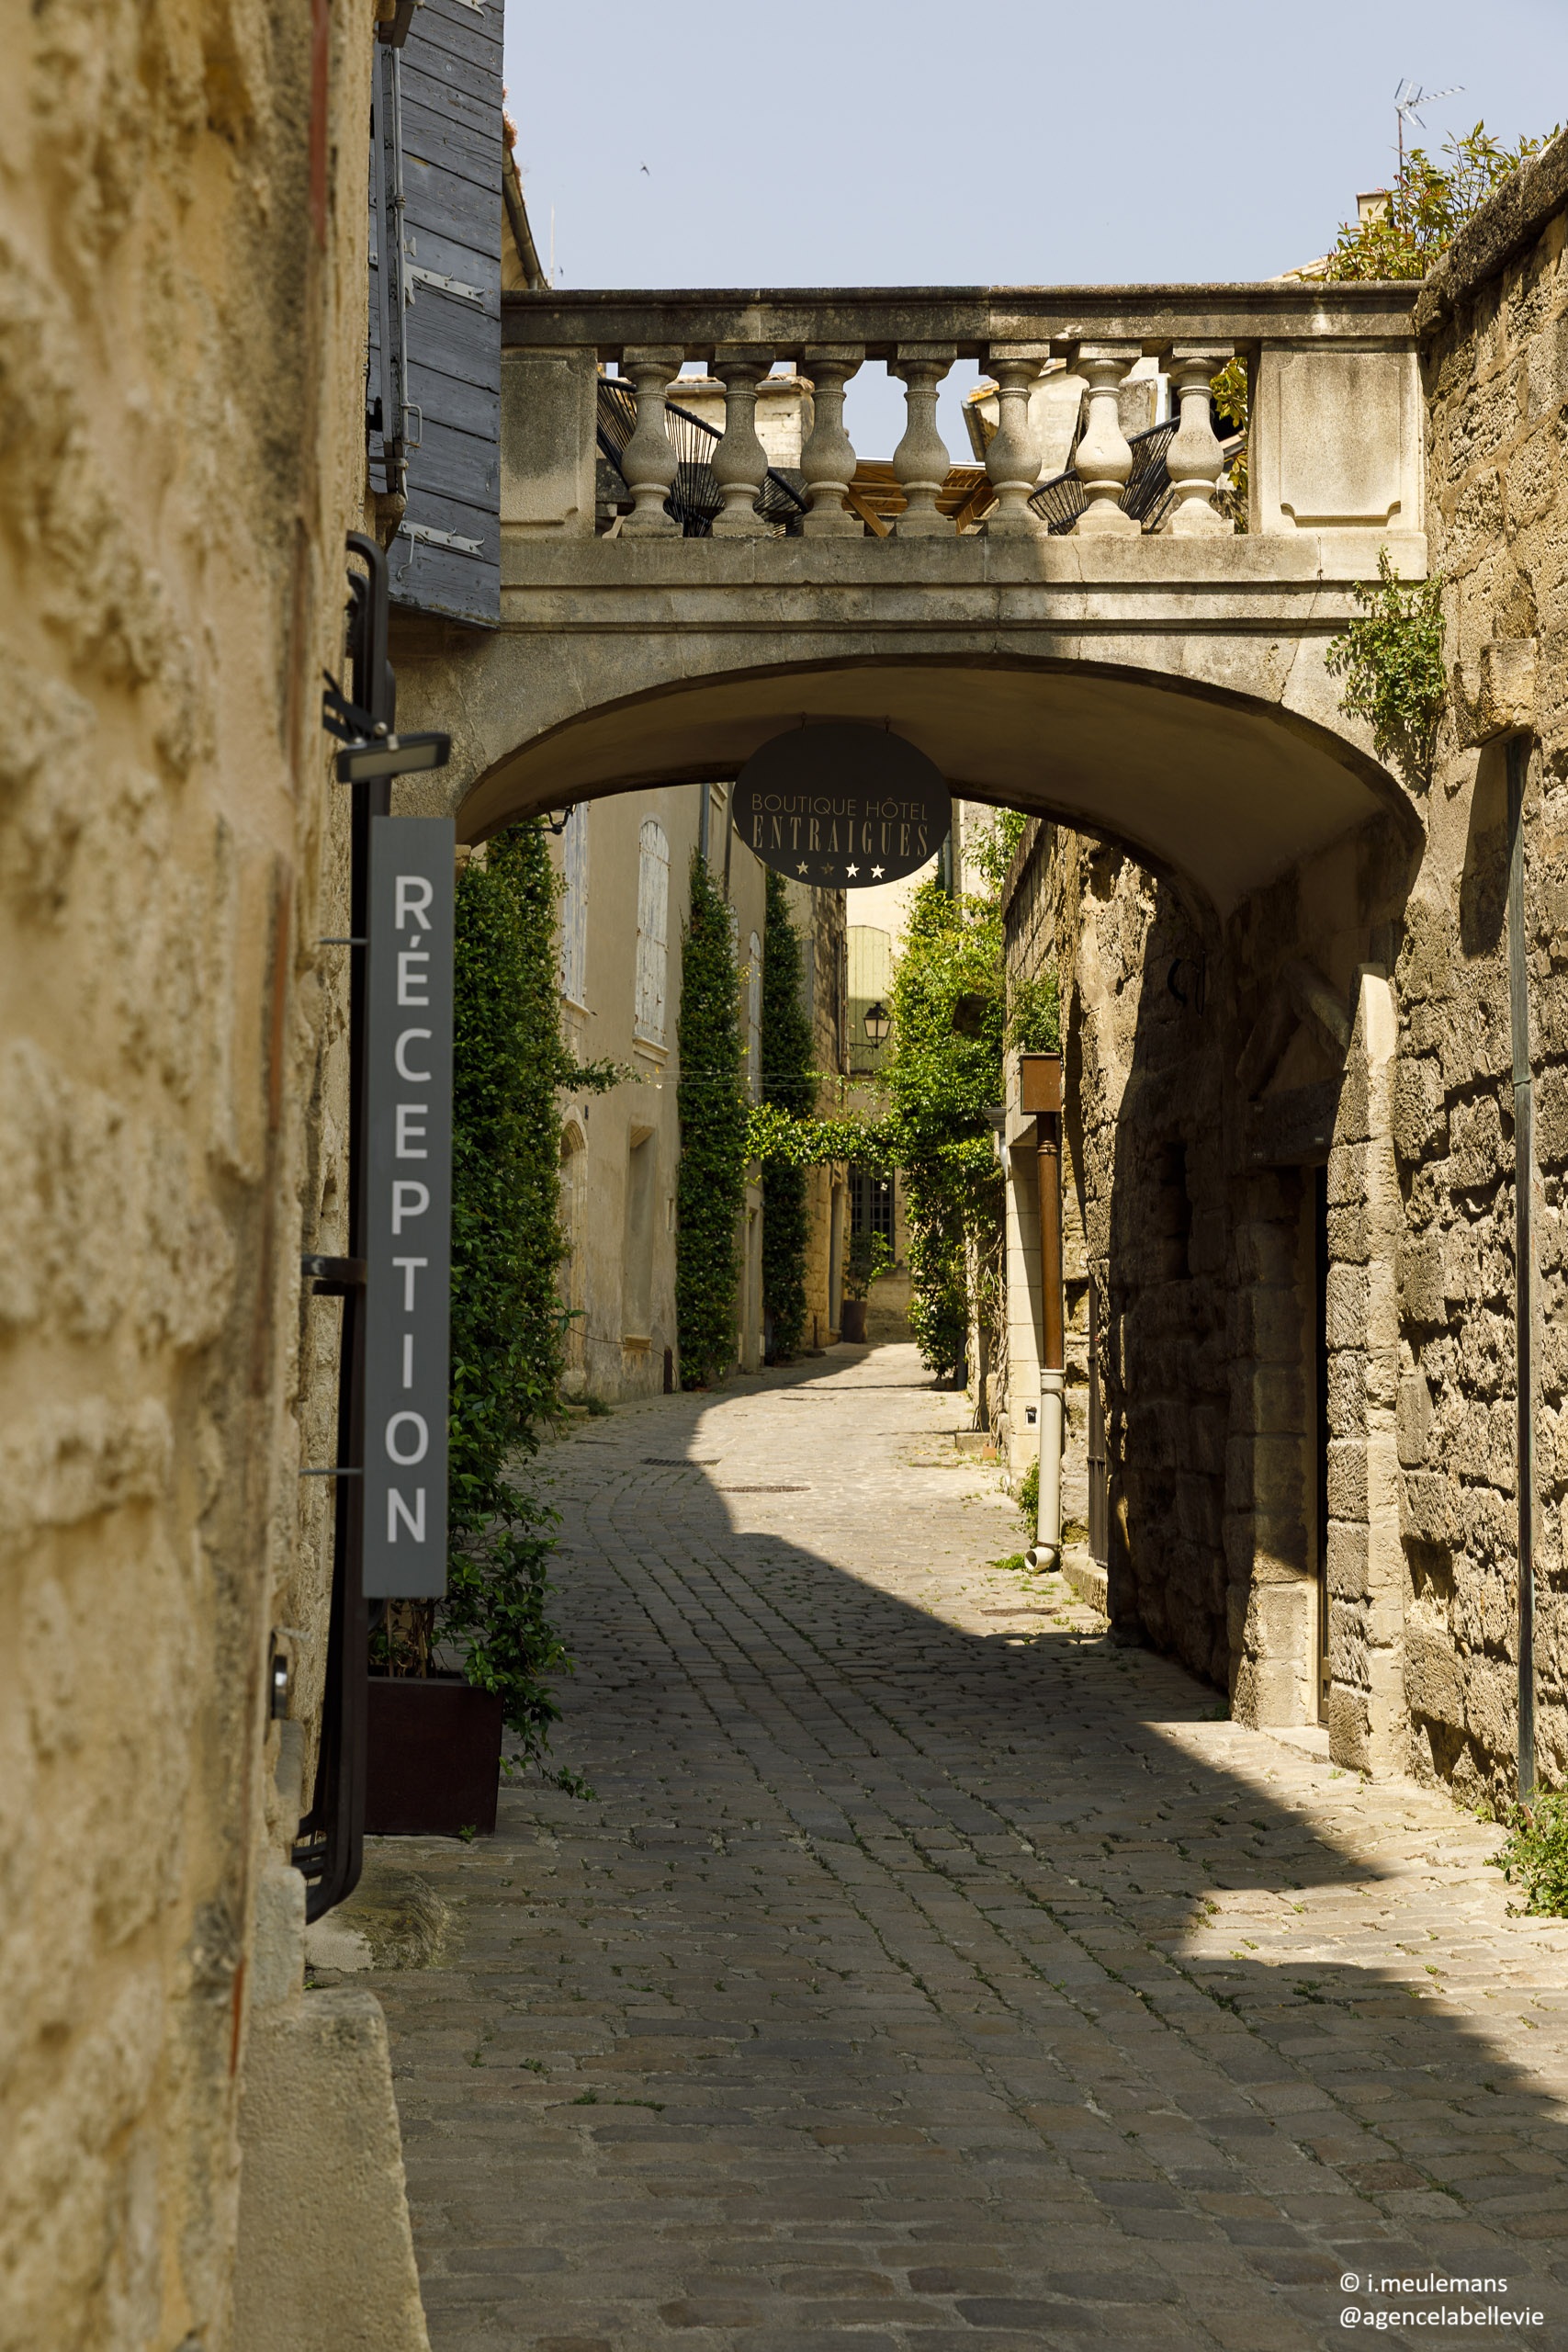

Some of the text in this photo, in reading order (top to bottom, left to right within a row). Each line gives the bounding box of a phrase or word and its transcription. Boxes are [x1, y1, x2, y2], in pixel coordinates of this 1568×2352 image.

[751, 793, 928, 821] BOUTIQUE HÔTEL
[751, 815, 929, 858] ENTRAIGUES
[385, 875, 434, 1544] RÉCEPTION
